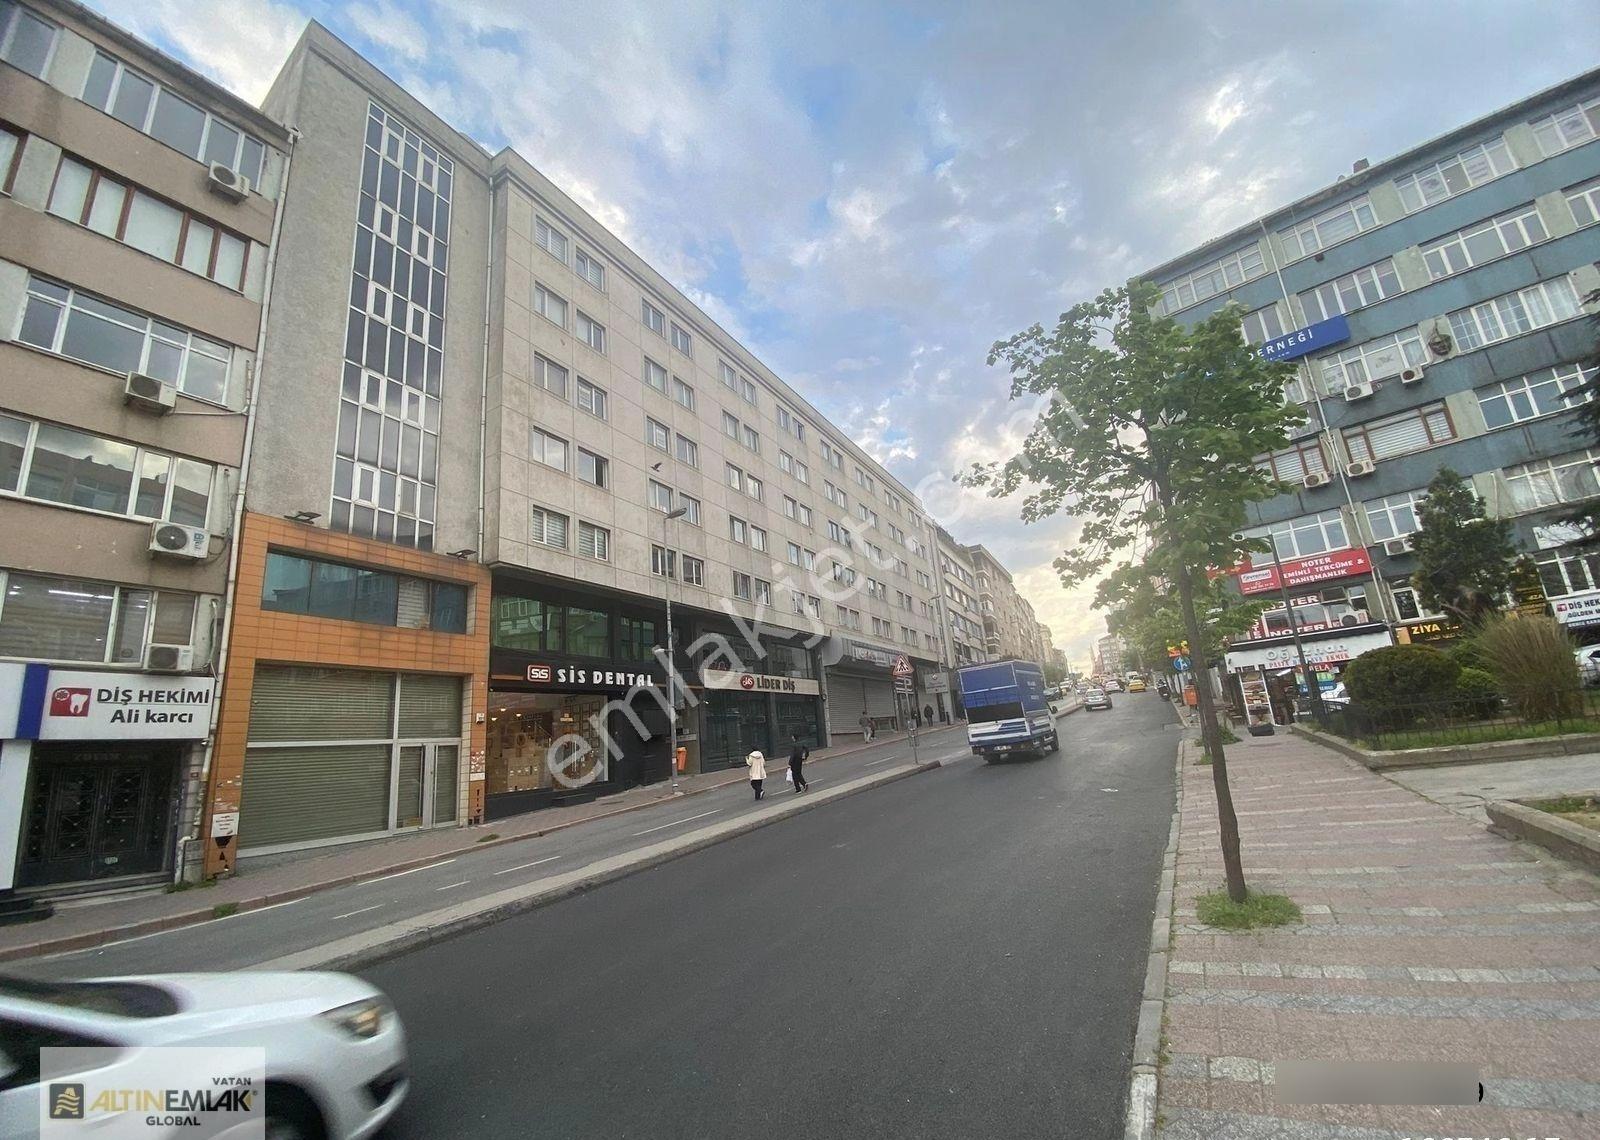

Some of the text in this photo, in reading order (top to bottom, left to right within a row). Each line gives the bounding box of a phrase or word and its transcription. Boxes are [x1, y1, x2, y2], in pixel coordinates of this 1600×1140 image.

[1282, 568, 1310, 579] EMİNLİ
[1315, 560, 1354, 573] TERCÜME
[1301, 557, 1331, 568] NOTER
[1290, 569, 1348, 585] DANIŞMANLIK
[1411, 623, 1442, 635] ZİYA
[592, 670, 654, 687] DENTAL
[757, 675, 781, 690] LİDER
[783, 678, 796, 692] DİŞ
[97, 686, 210, 706] DİŞ HEKİMİ
[110, 709, 193, 724] Ali karcı
